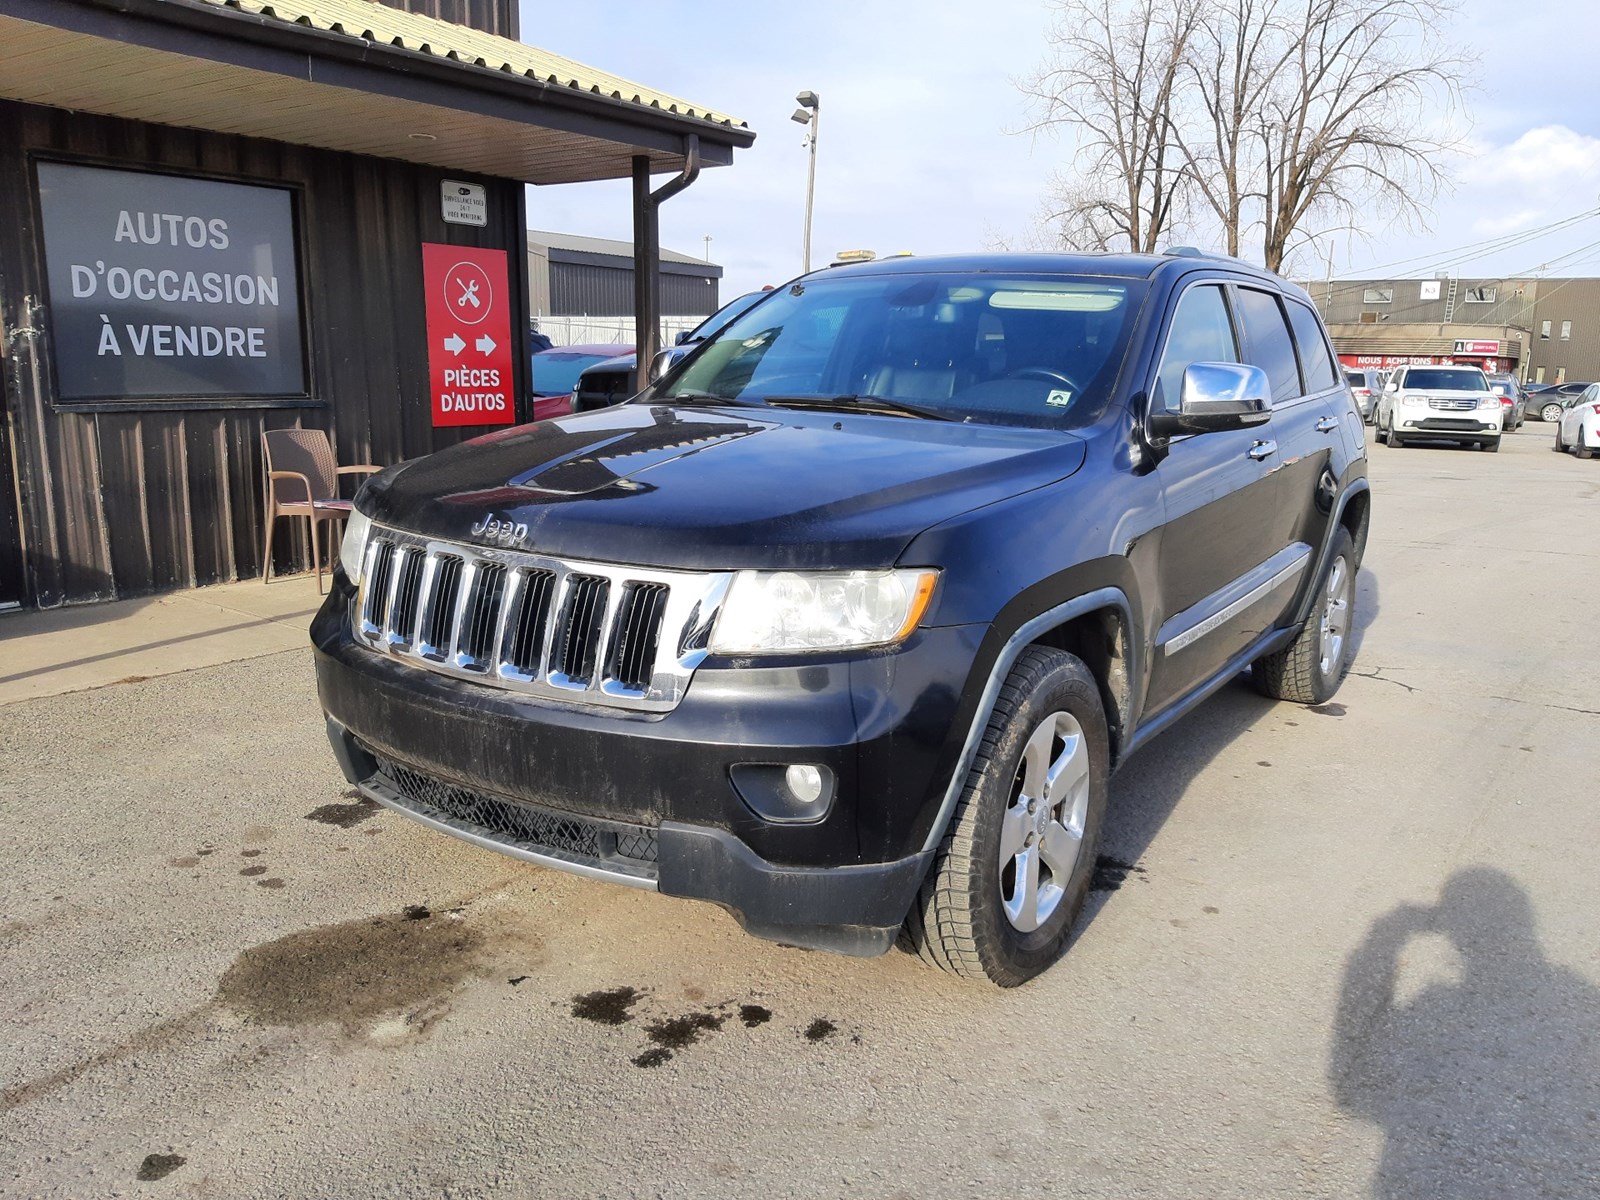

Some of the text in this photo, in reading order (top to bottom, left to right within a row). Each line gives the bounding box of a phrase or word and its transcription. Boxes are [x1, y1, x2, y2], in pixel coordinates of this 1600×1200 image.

[114, 210, 229, 250] AUTOS
[70, 260, 279, 306] D'OCCASION
[97, 313, 267, 358] À VENDRE
[444, 364, 500, 387] PIÈCES
[1357, 356, 1382, 364] NOUS
[441, 391, 506, 412] D'AUTOS
[471, 513, 529, 545] Jeep
